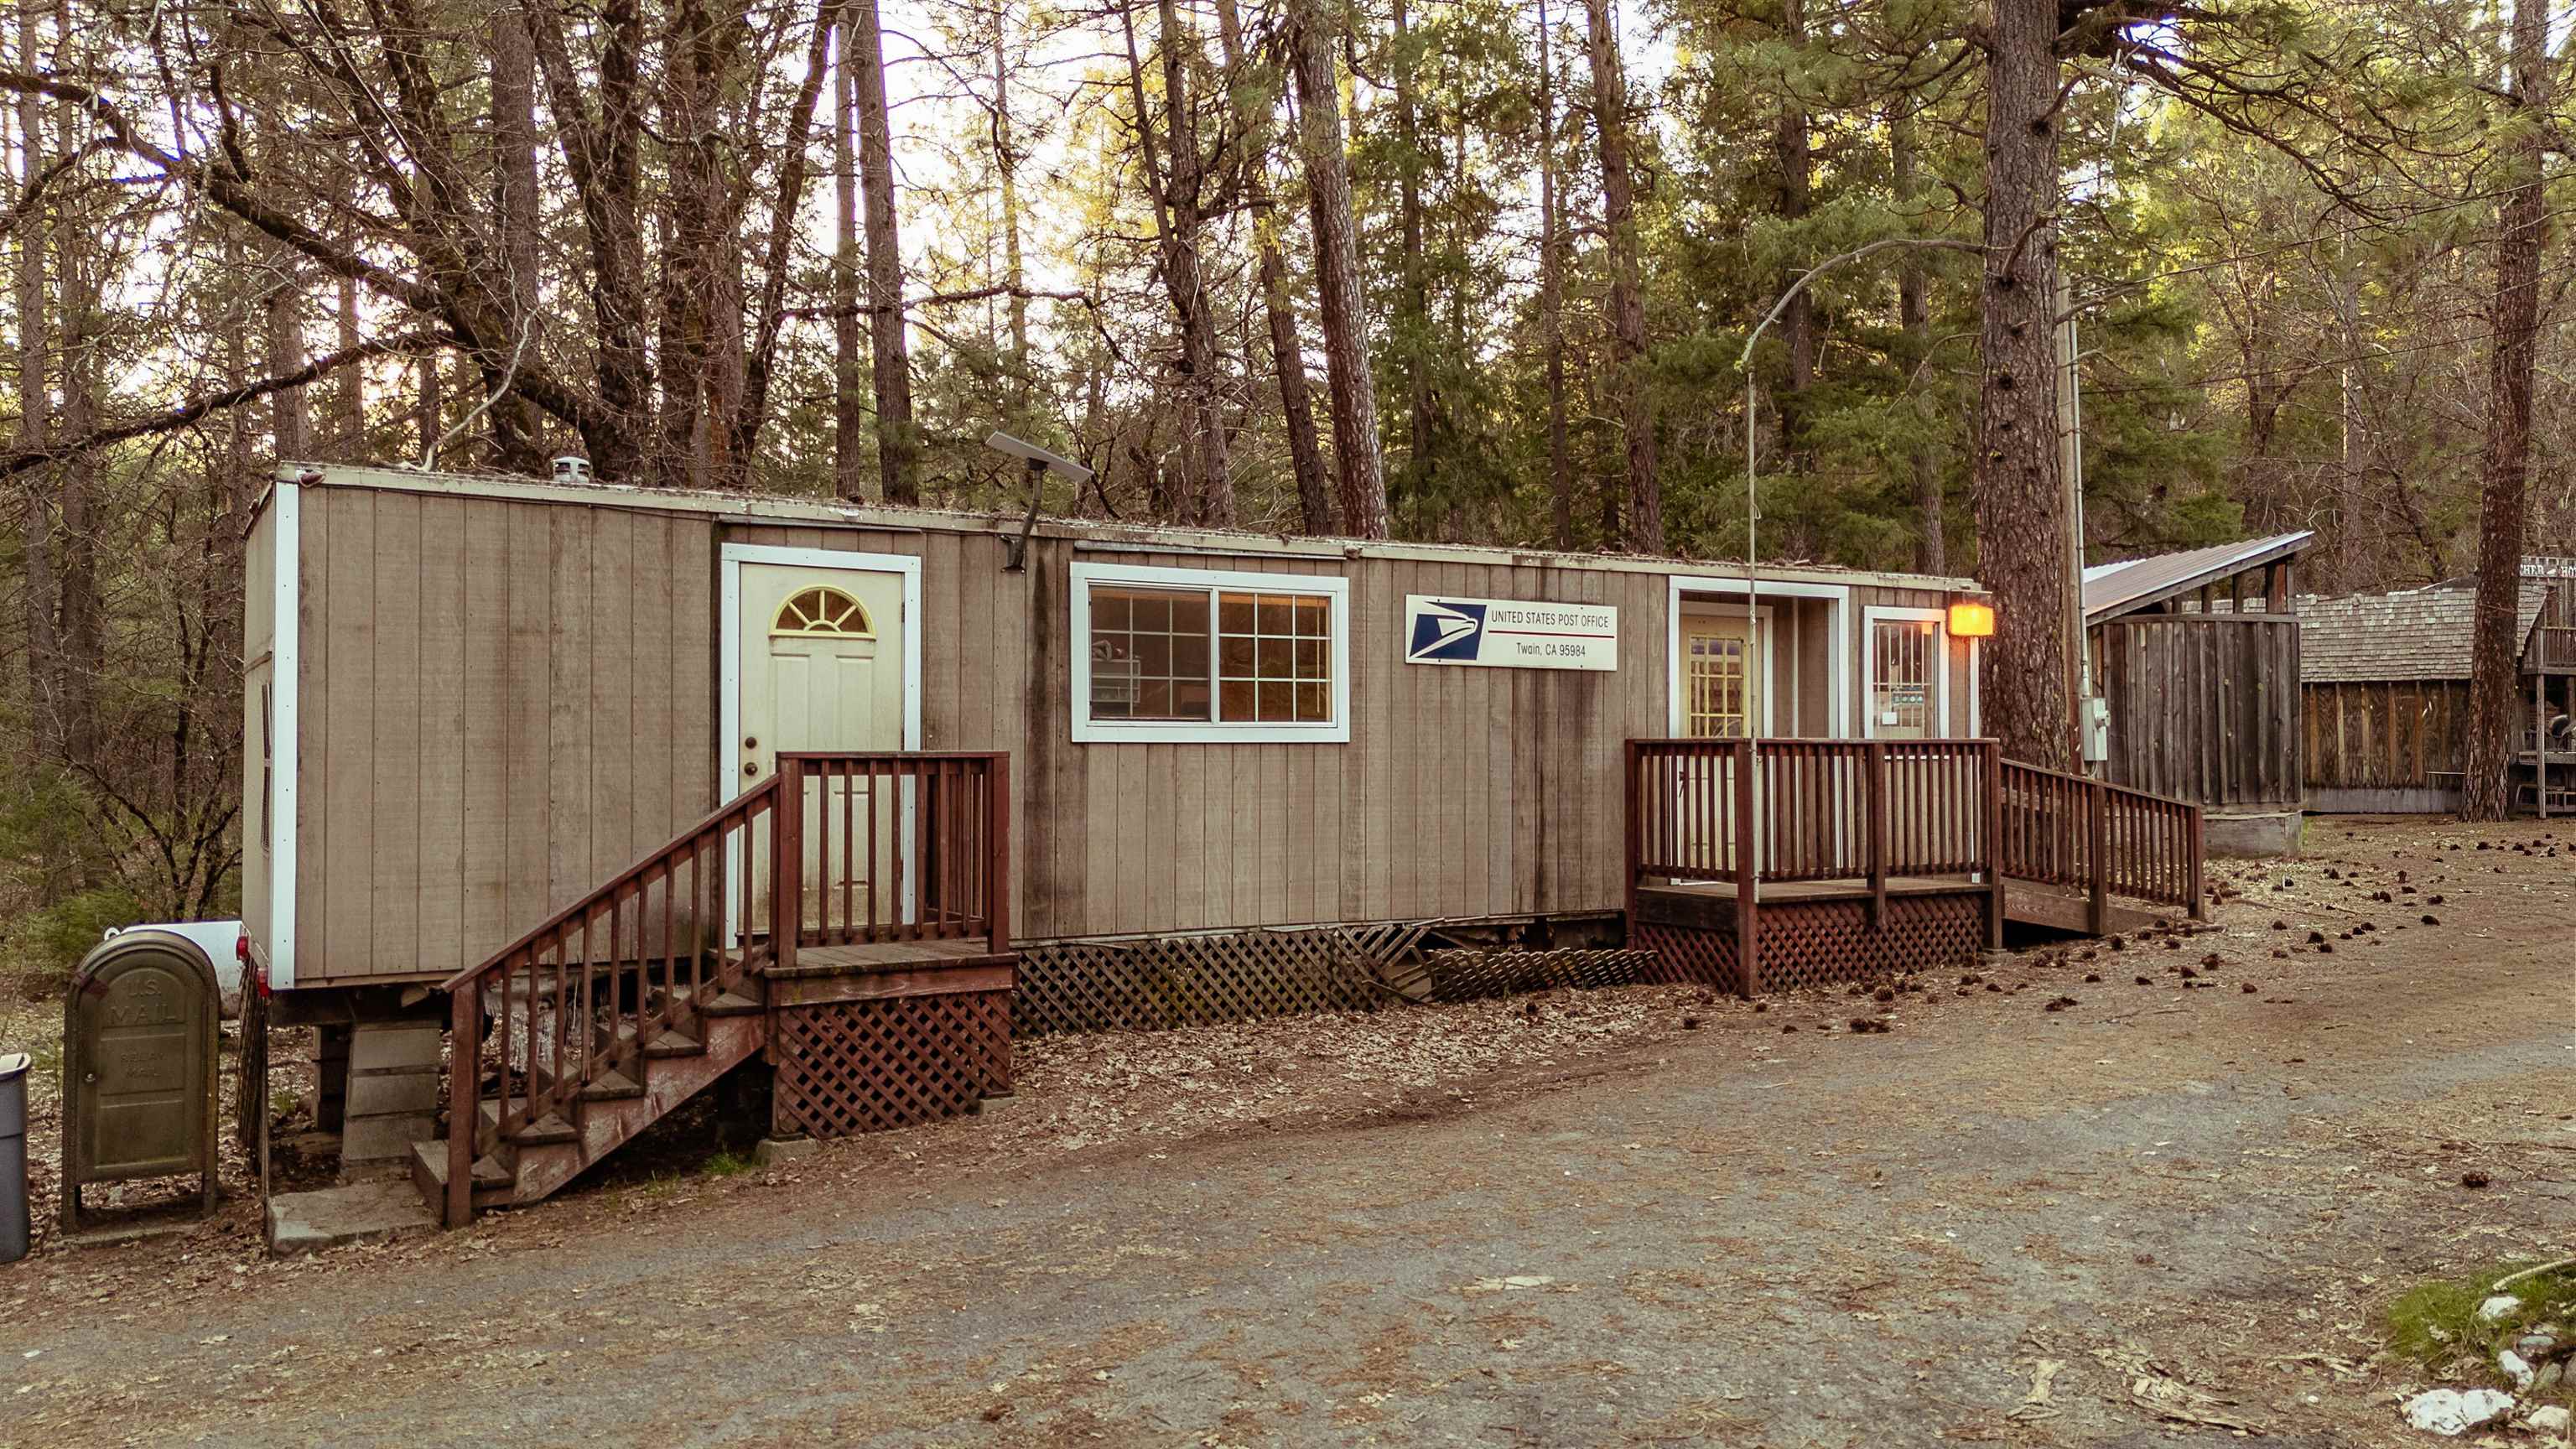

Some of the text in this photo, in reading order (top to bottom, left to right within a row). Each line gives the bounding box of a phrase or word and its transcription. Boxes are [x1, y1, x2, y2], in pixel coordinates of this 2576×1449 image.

[1491, 610, 1609, 628] UNITED STATES POST OFFICE
[1516, 642, 1586, 657] Twain, CA 95984
[127, 979, 162, 997] U.S.
[108, 1001, 176, 1024] MAIL
